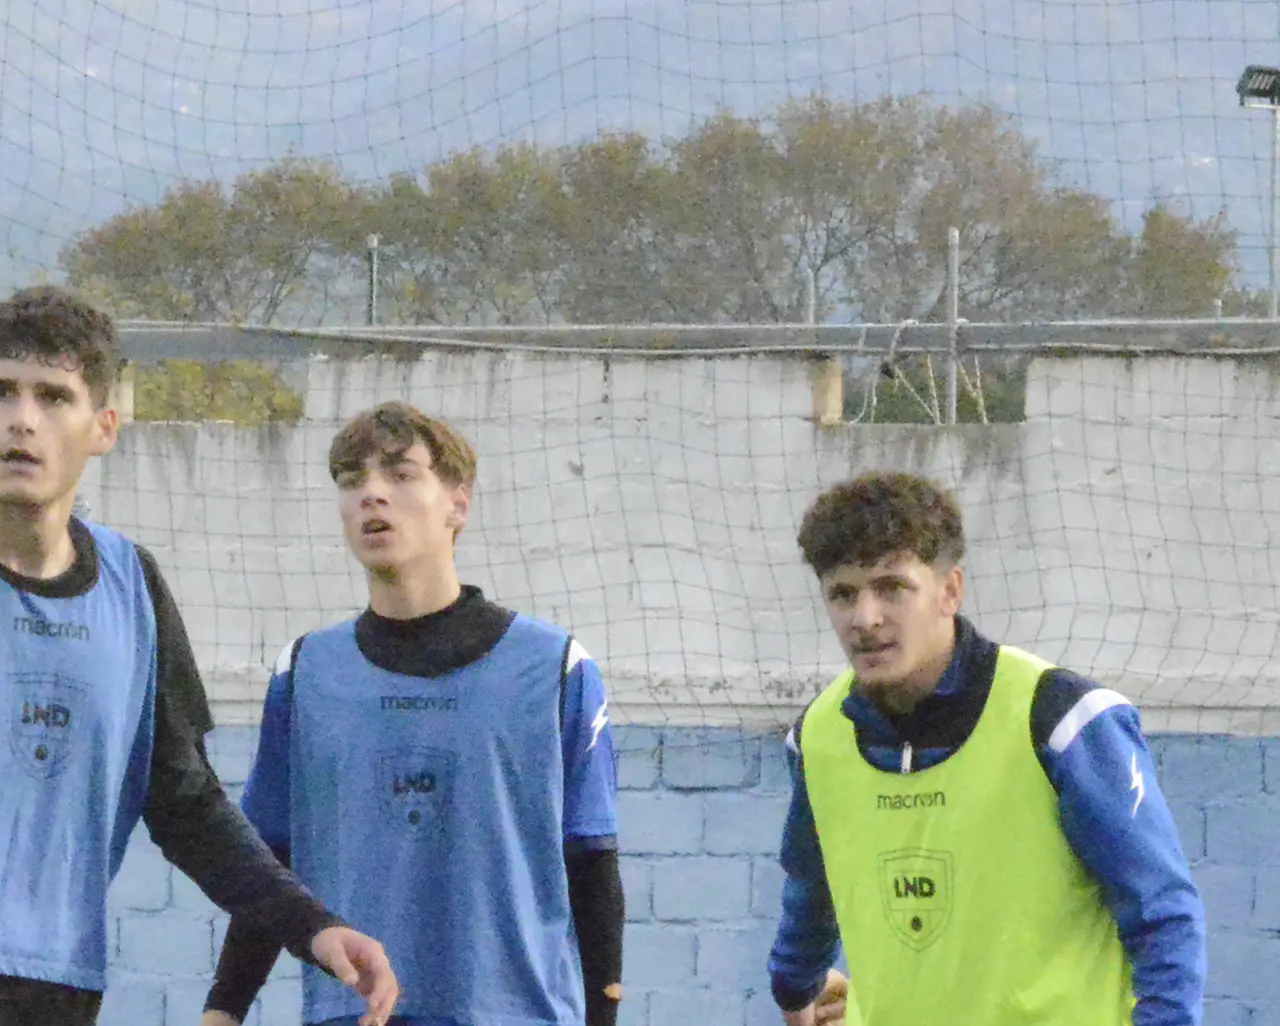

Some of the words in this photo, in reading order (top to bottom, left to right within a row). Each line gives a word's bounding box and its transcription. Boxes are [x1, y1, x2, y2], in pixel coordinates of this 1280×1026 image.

[15, 615, 90, 642] macron
[22, 701, 71, 728] LND
[877, 790, 946, 810] macron
[894, 875, 936, 898] LND
